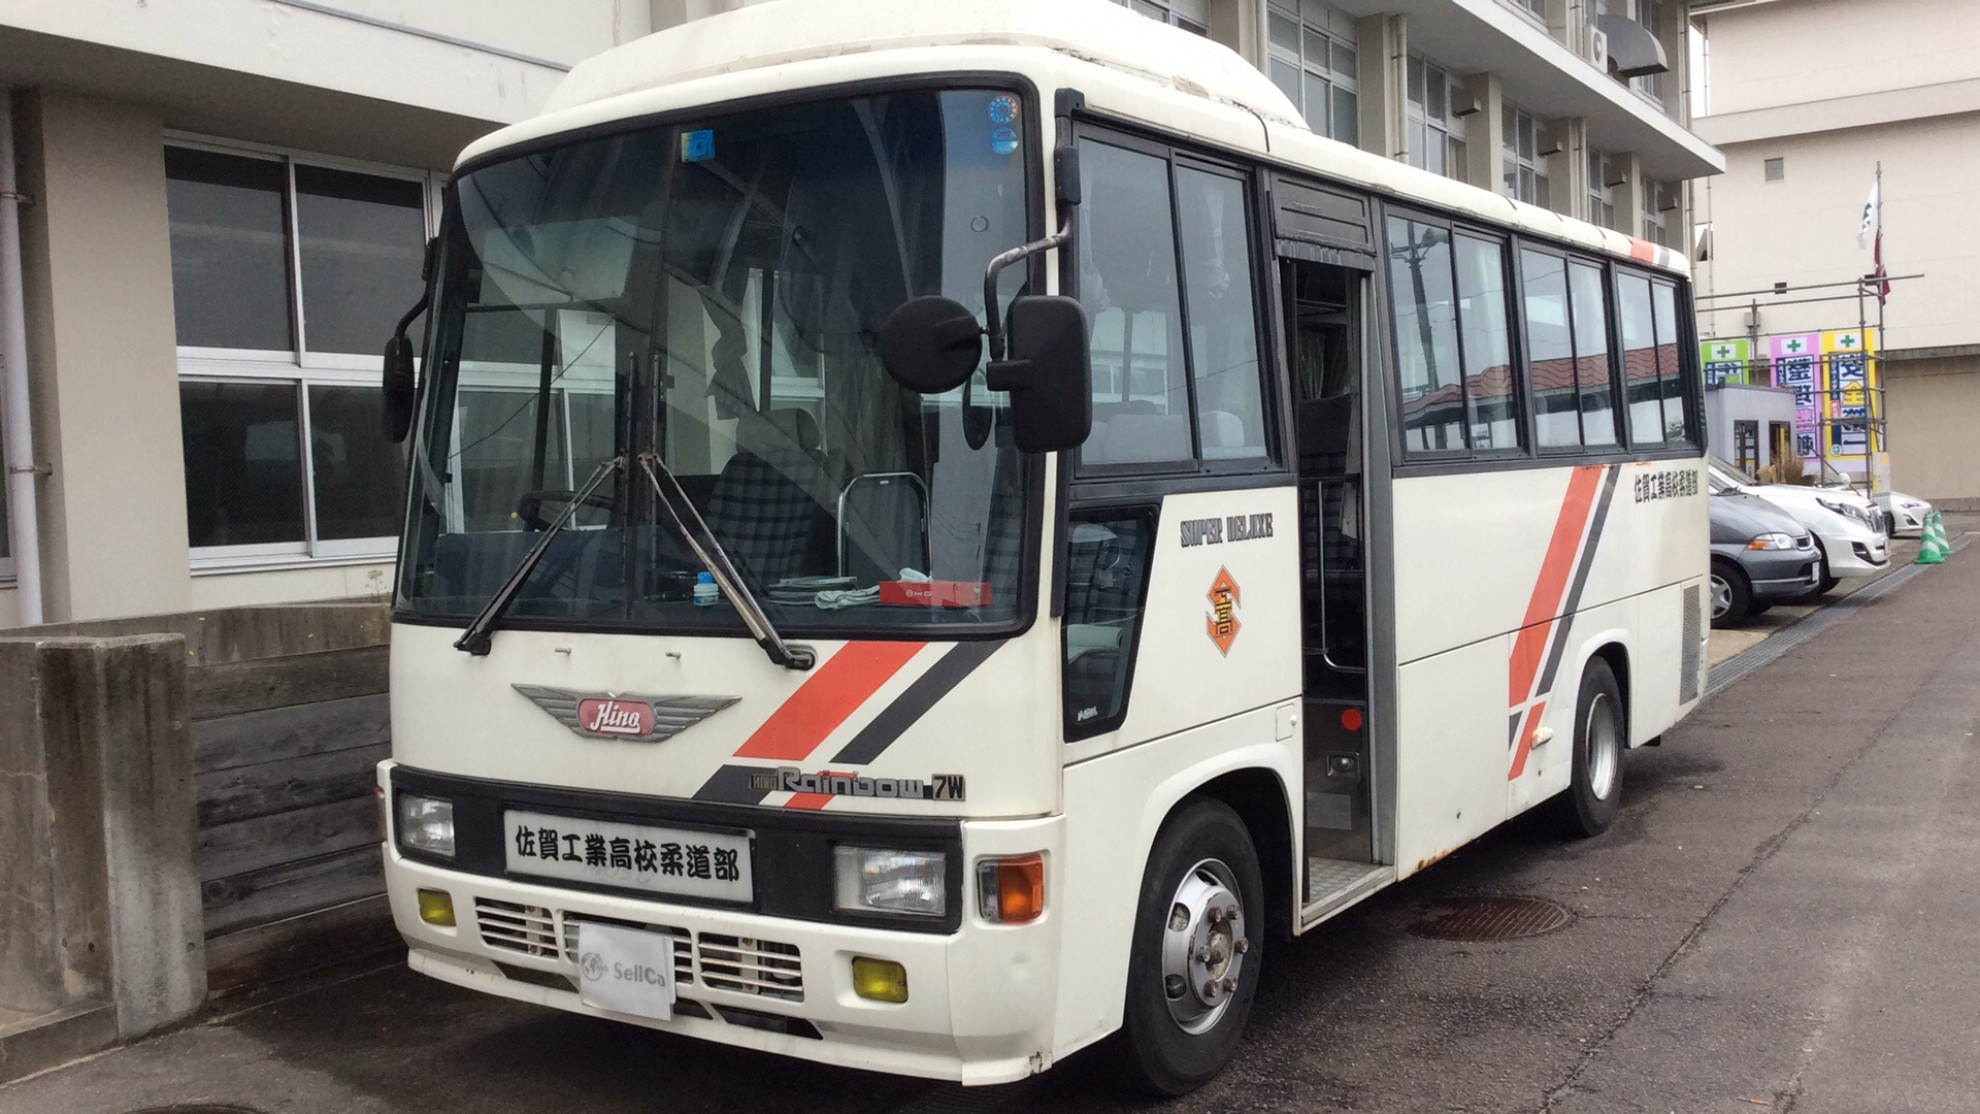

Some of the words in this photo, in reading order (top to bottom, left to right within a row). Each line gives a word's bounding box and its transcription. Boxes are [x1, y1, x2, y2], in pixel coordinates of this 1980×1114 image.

[1181, 517, 1223, 548] SUPER
[1226, 513, 1273, 543] DELUXE
[590, 700, 640, 733] Hino
[778, 766, 923, 799] Rainbow
[933, 774, 965, 799] 7W
[515, 825, 739, 882] 佐賀工業高校柔道部
